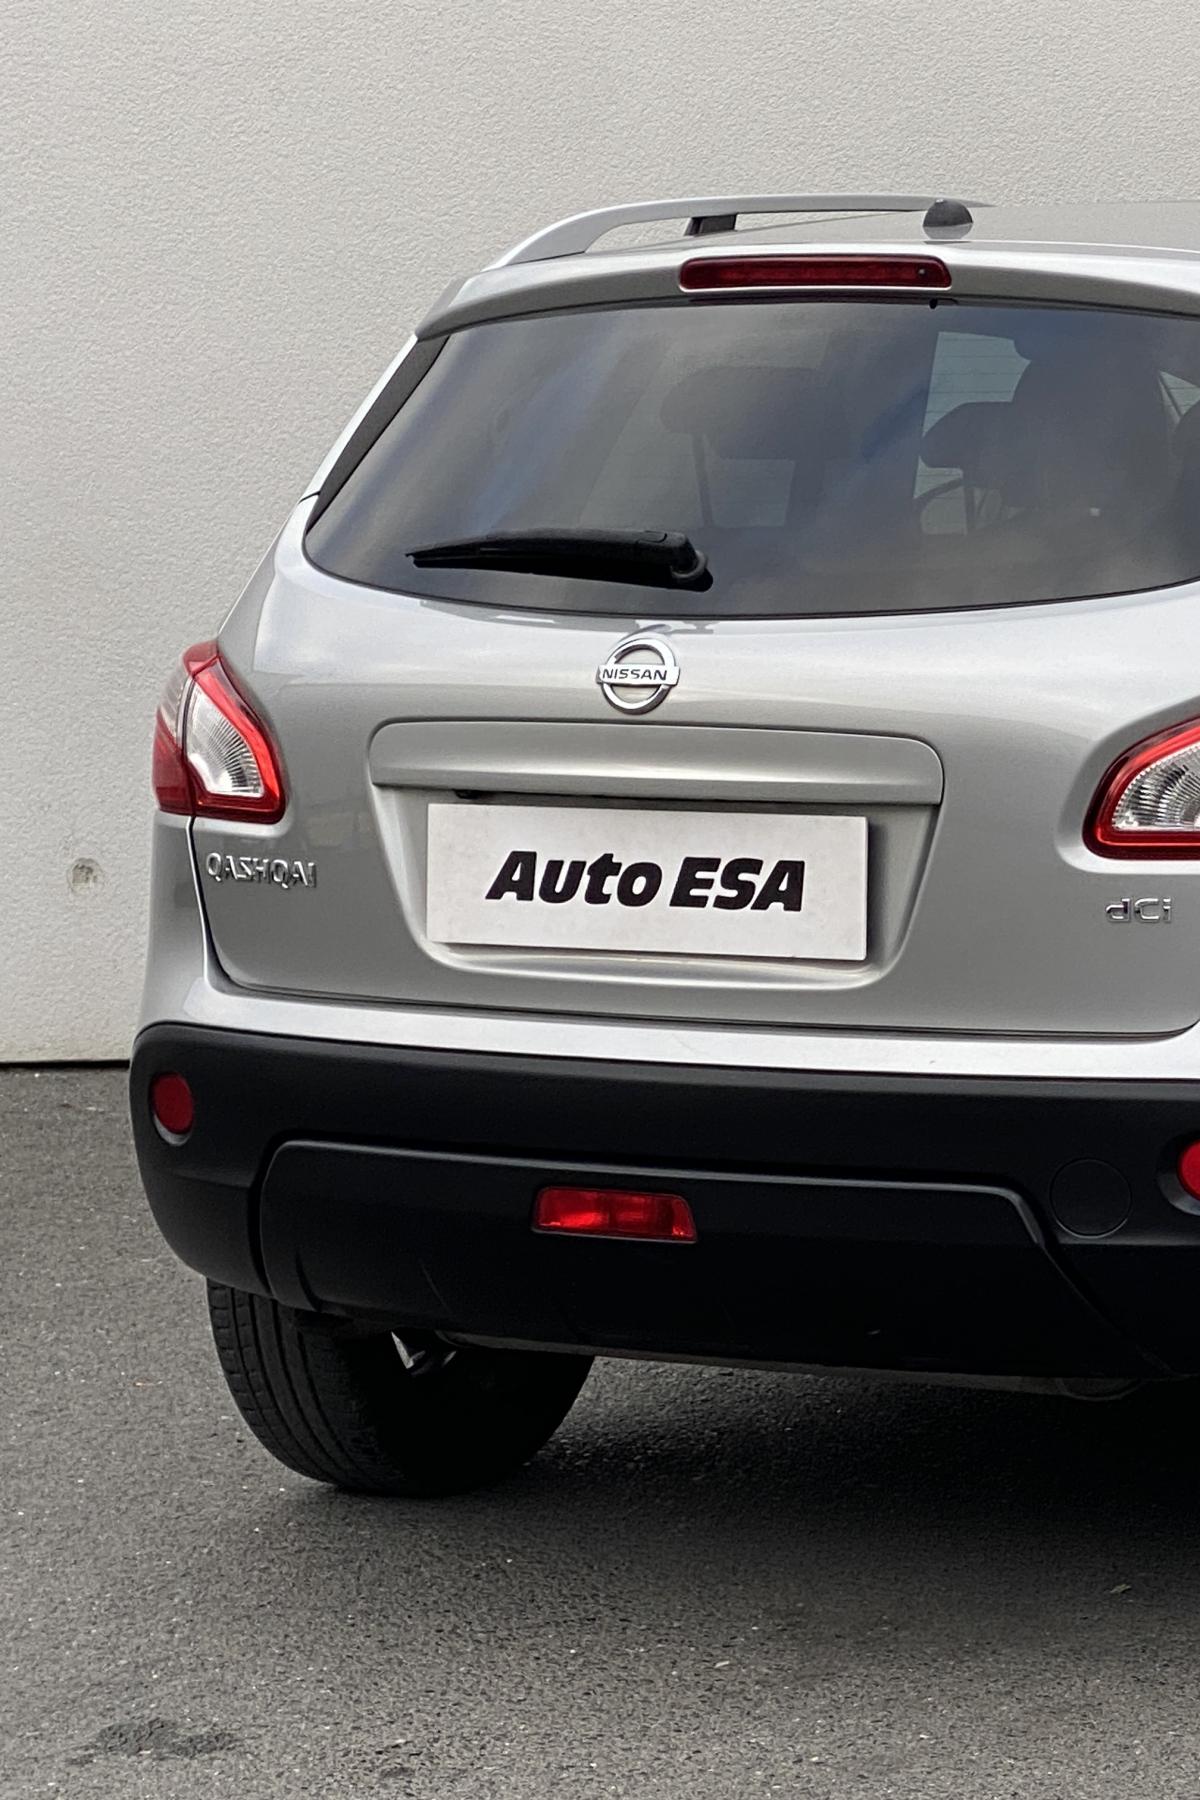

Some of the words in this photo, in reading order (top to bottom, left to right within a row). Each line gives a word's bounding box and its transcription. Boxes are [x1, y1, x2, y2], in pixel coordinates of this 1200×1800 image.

[602, 668, 668, 681] NISSAN
[206, 852, 317, 889] QASHQAI
[485, 850, 662, 907] Auto
[669, 857, 806, 912] ESA
[1105, 898, 1172, 923] dCi
